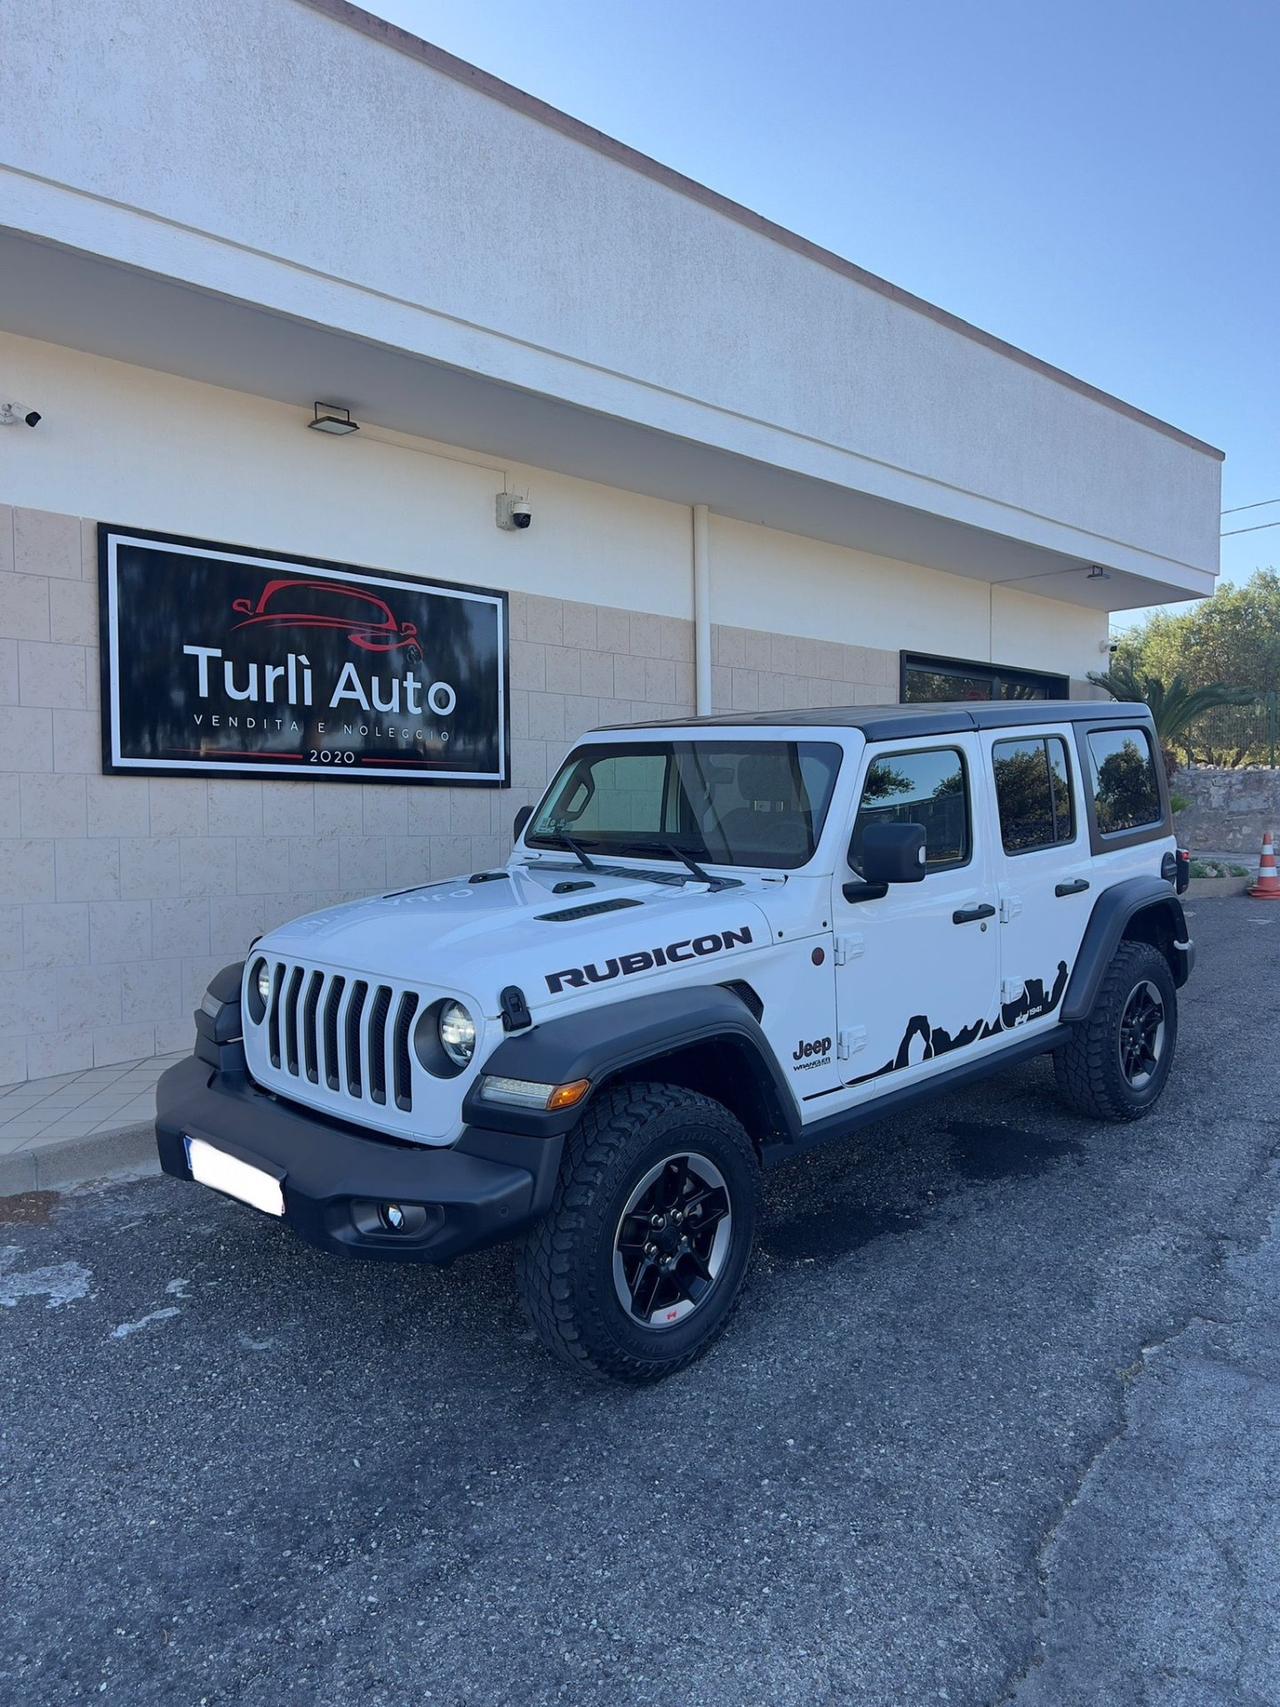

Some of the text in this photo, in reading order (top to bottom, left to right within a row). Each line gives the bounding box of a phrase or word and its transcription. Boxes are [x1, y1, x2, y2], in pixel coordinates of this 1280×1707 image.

[183, 644, 457, 716] Turlì Auto
[193, 713, 451, 742] VENDITA E NOLEGGIO
[309, 749, 356, 764] 2020
[544, 926, 753, 994] RUBICON
[793, 1037, 832, 1060] Jeep
